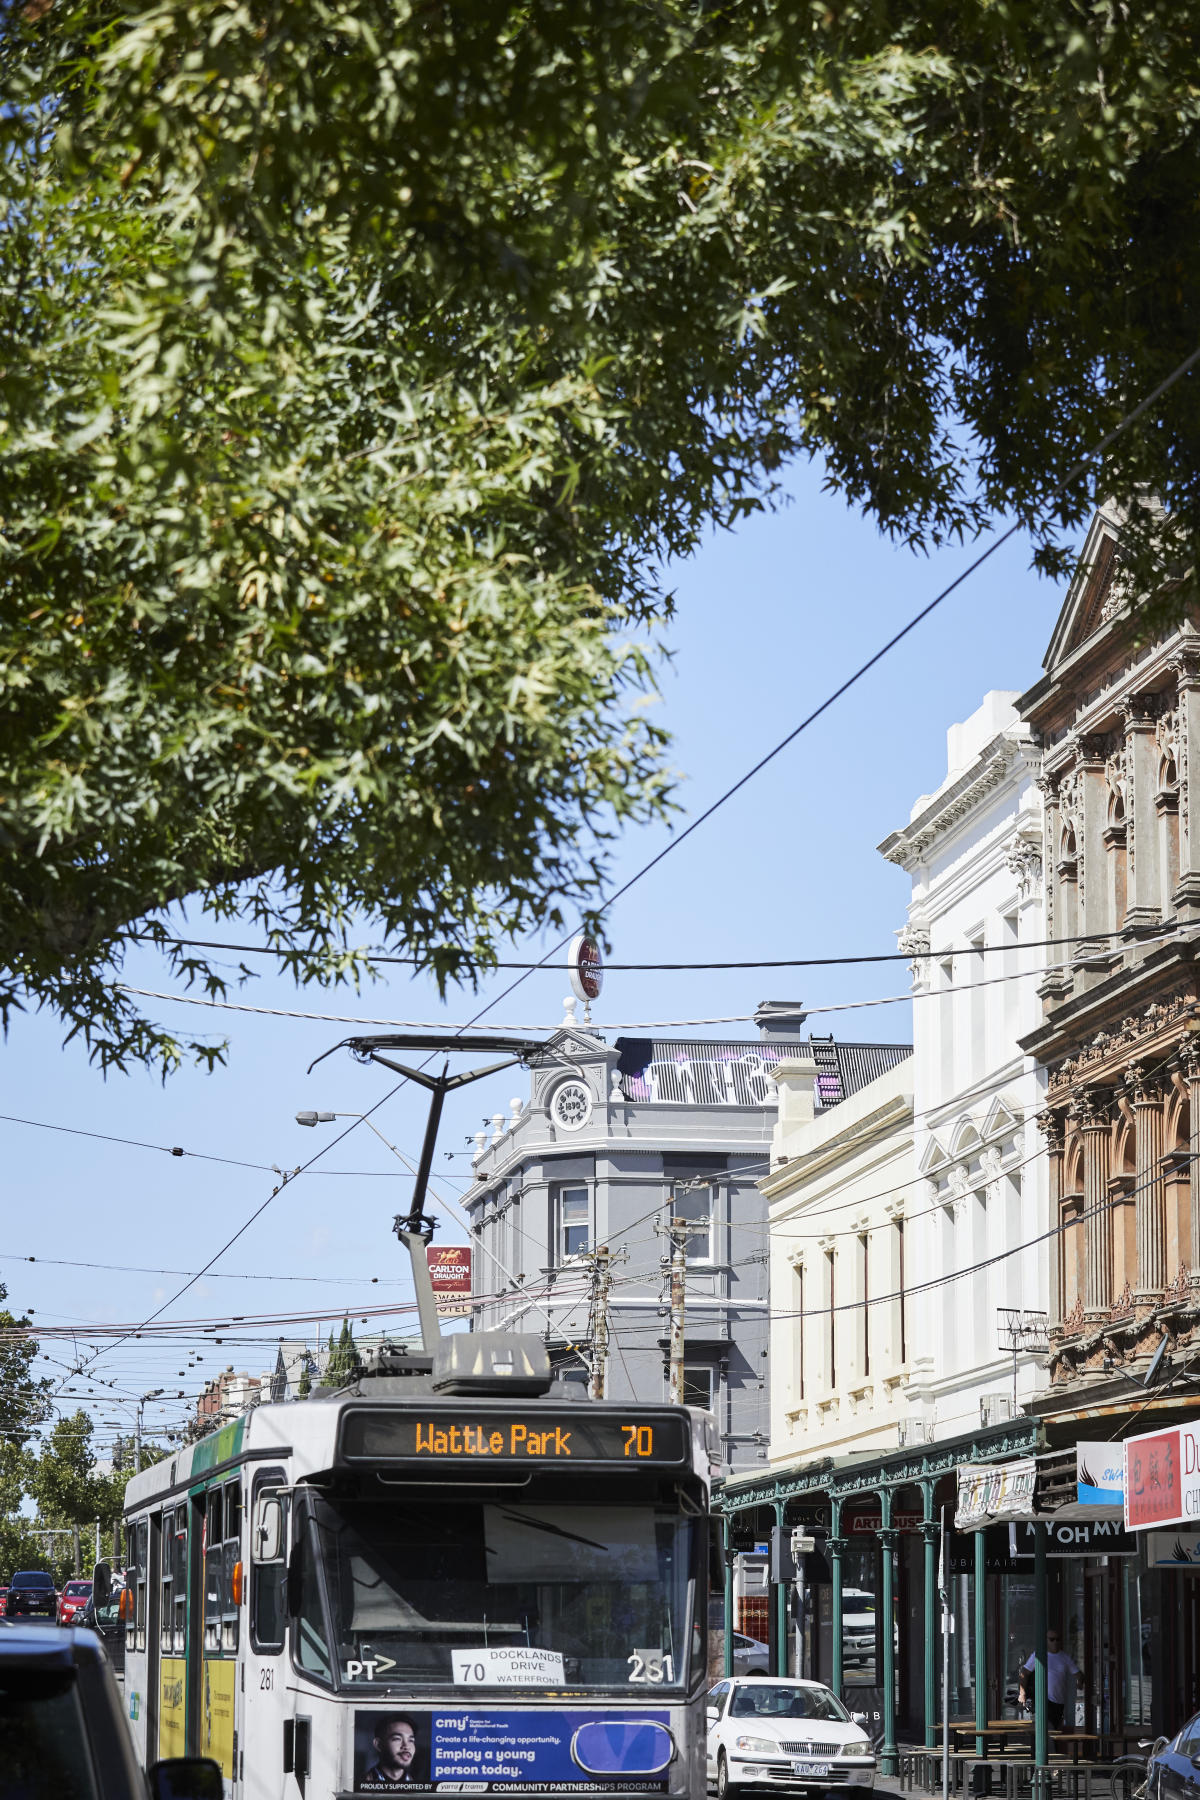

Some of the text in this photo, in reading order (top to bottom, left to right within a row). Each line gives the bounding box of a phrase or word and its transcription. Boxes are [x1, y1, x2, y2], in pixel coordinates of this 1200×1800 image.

[560, 1089, 585, 1103] SWAN
[566, 1101, 580, 1110] 1890
[558, 1105, 587, 1124] HOTEL
[429, 1265, 469, 1273] CARLTON
[416, 1423, 653, 1456] Wattle Park 70
[855, 1517, 923, 1529] ARTUSE
[1057, 1527, 1089, 1543] OH
[1093, 1521, 1121, 1535] MY
[490, 1651, 562, 1663] DOCKLANDS
[460, 1662, 545, 1681] 70 DRIVE
[260, 1668, 273, 1690] 281
[497, 1676, 560, 1685] WATERFRONT
[469, 1736, 516, 1744] life-changing
[517, 1736, 561, 1745] opportunity.
[435, 1748, 535, 1762] Employ a young
[435, 1765, 522, 1777] person today.
[492, 1782, 661, 1791] COMMUNITY PARTNERSHIPS PROGRAM
